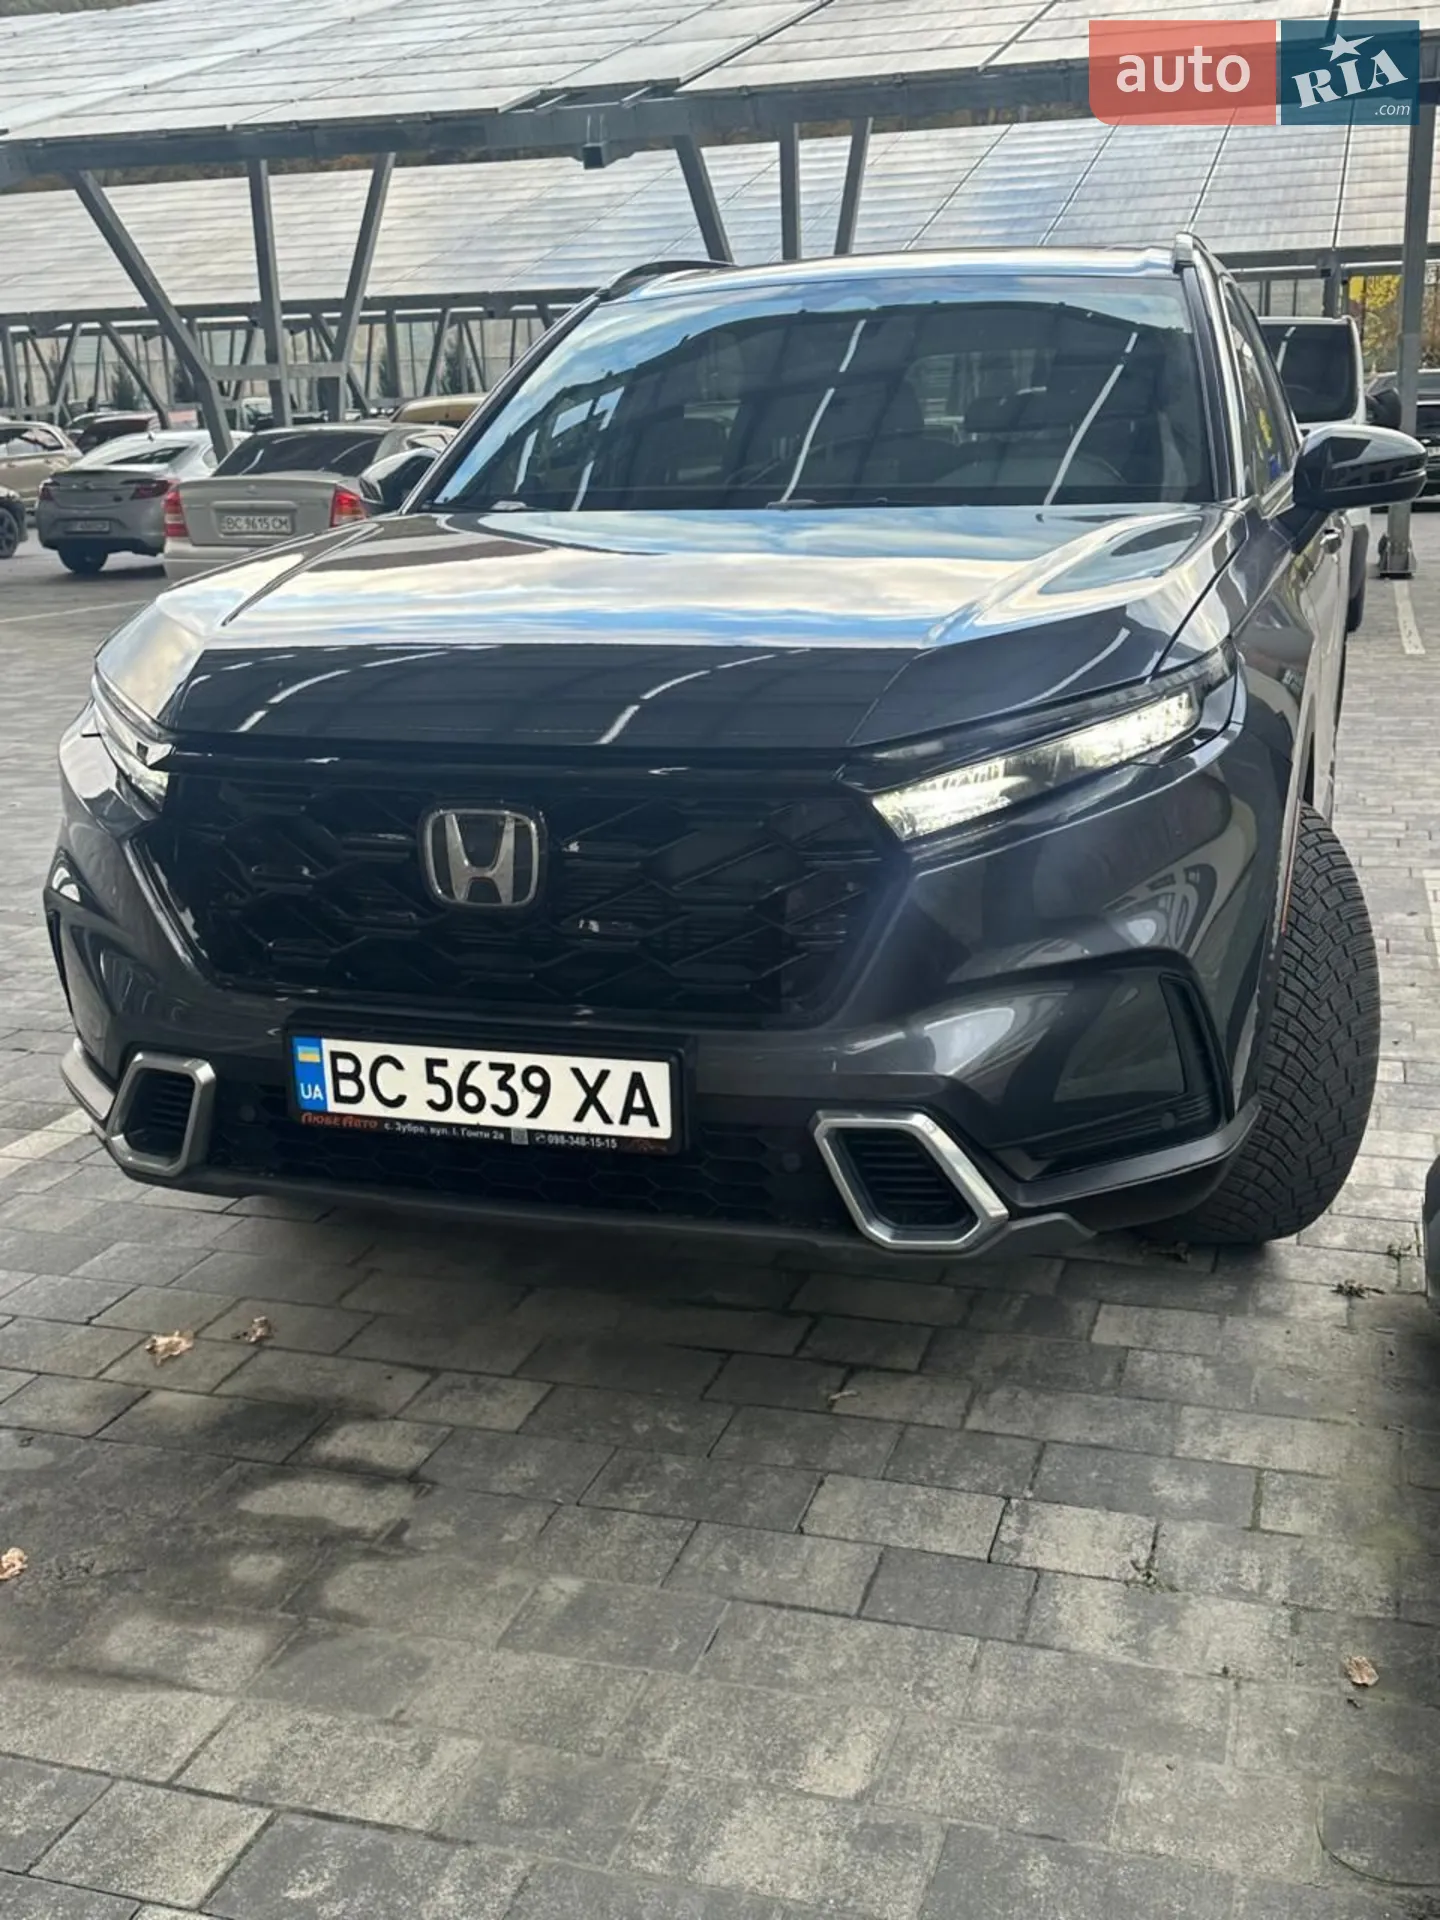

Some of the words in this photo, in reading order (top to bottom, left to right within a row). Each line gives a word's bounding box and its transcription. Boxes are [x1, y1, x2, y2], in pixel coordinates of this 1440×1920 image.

[300, 1083, 324, 1101] UA
[329, 1050, 408, 1109] BC
[425, 1058, 551, 1119] 5639
[570, 1067, 660, 1127] XA
